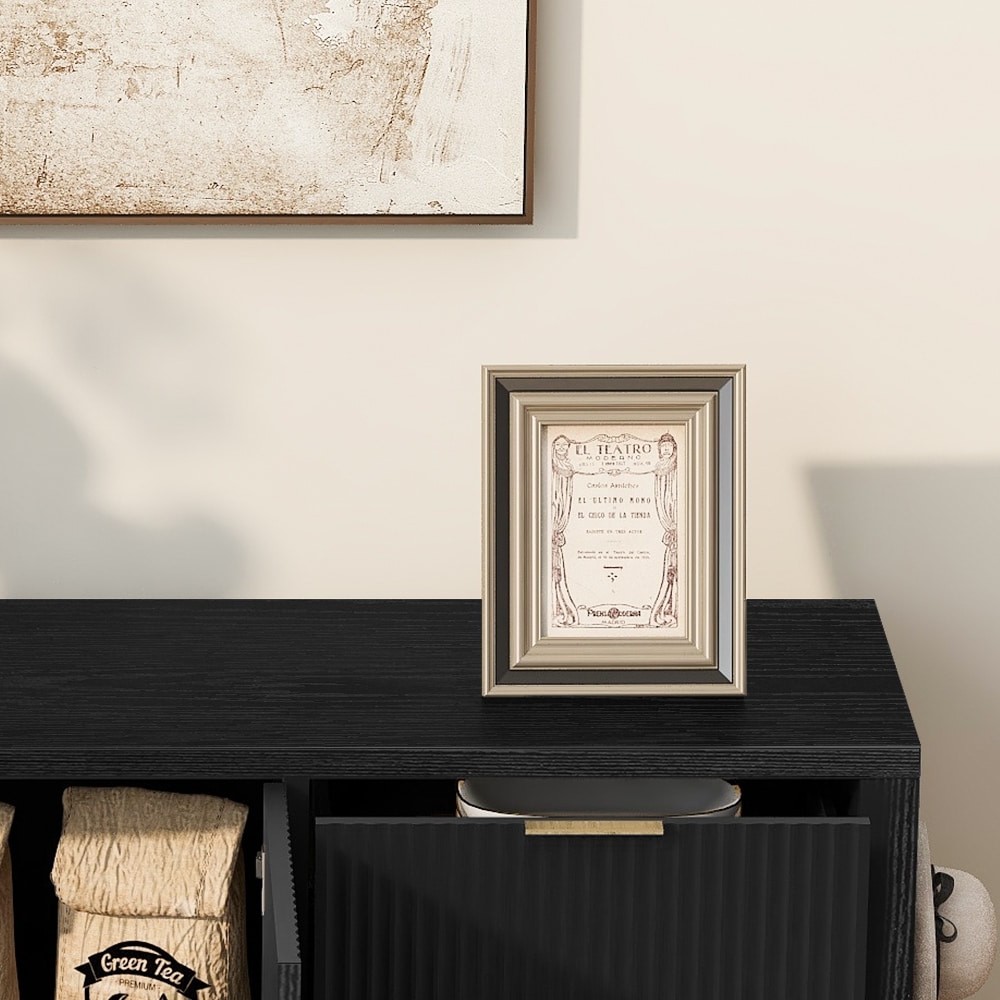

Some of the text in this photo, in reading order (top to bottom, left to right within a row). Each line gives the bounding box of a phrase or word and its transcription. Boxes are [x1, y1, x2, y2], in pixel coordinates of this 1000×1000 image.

[576, 443, 652, 455] EL TEATRO
[100, 953, 185, 985] Green Tea
[118, 978, 156, 991] PREMIUM
